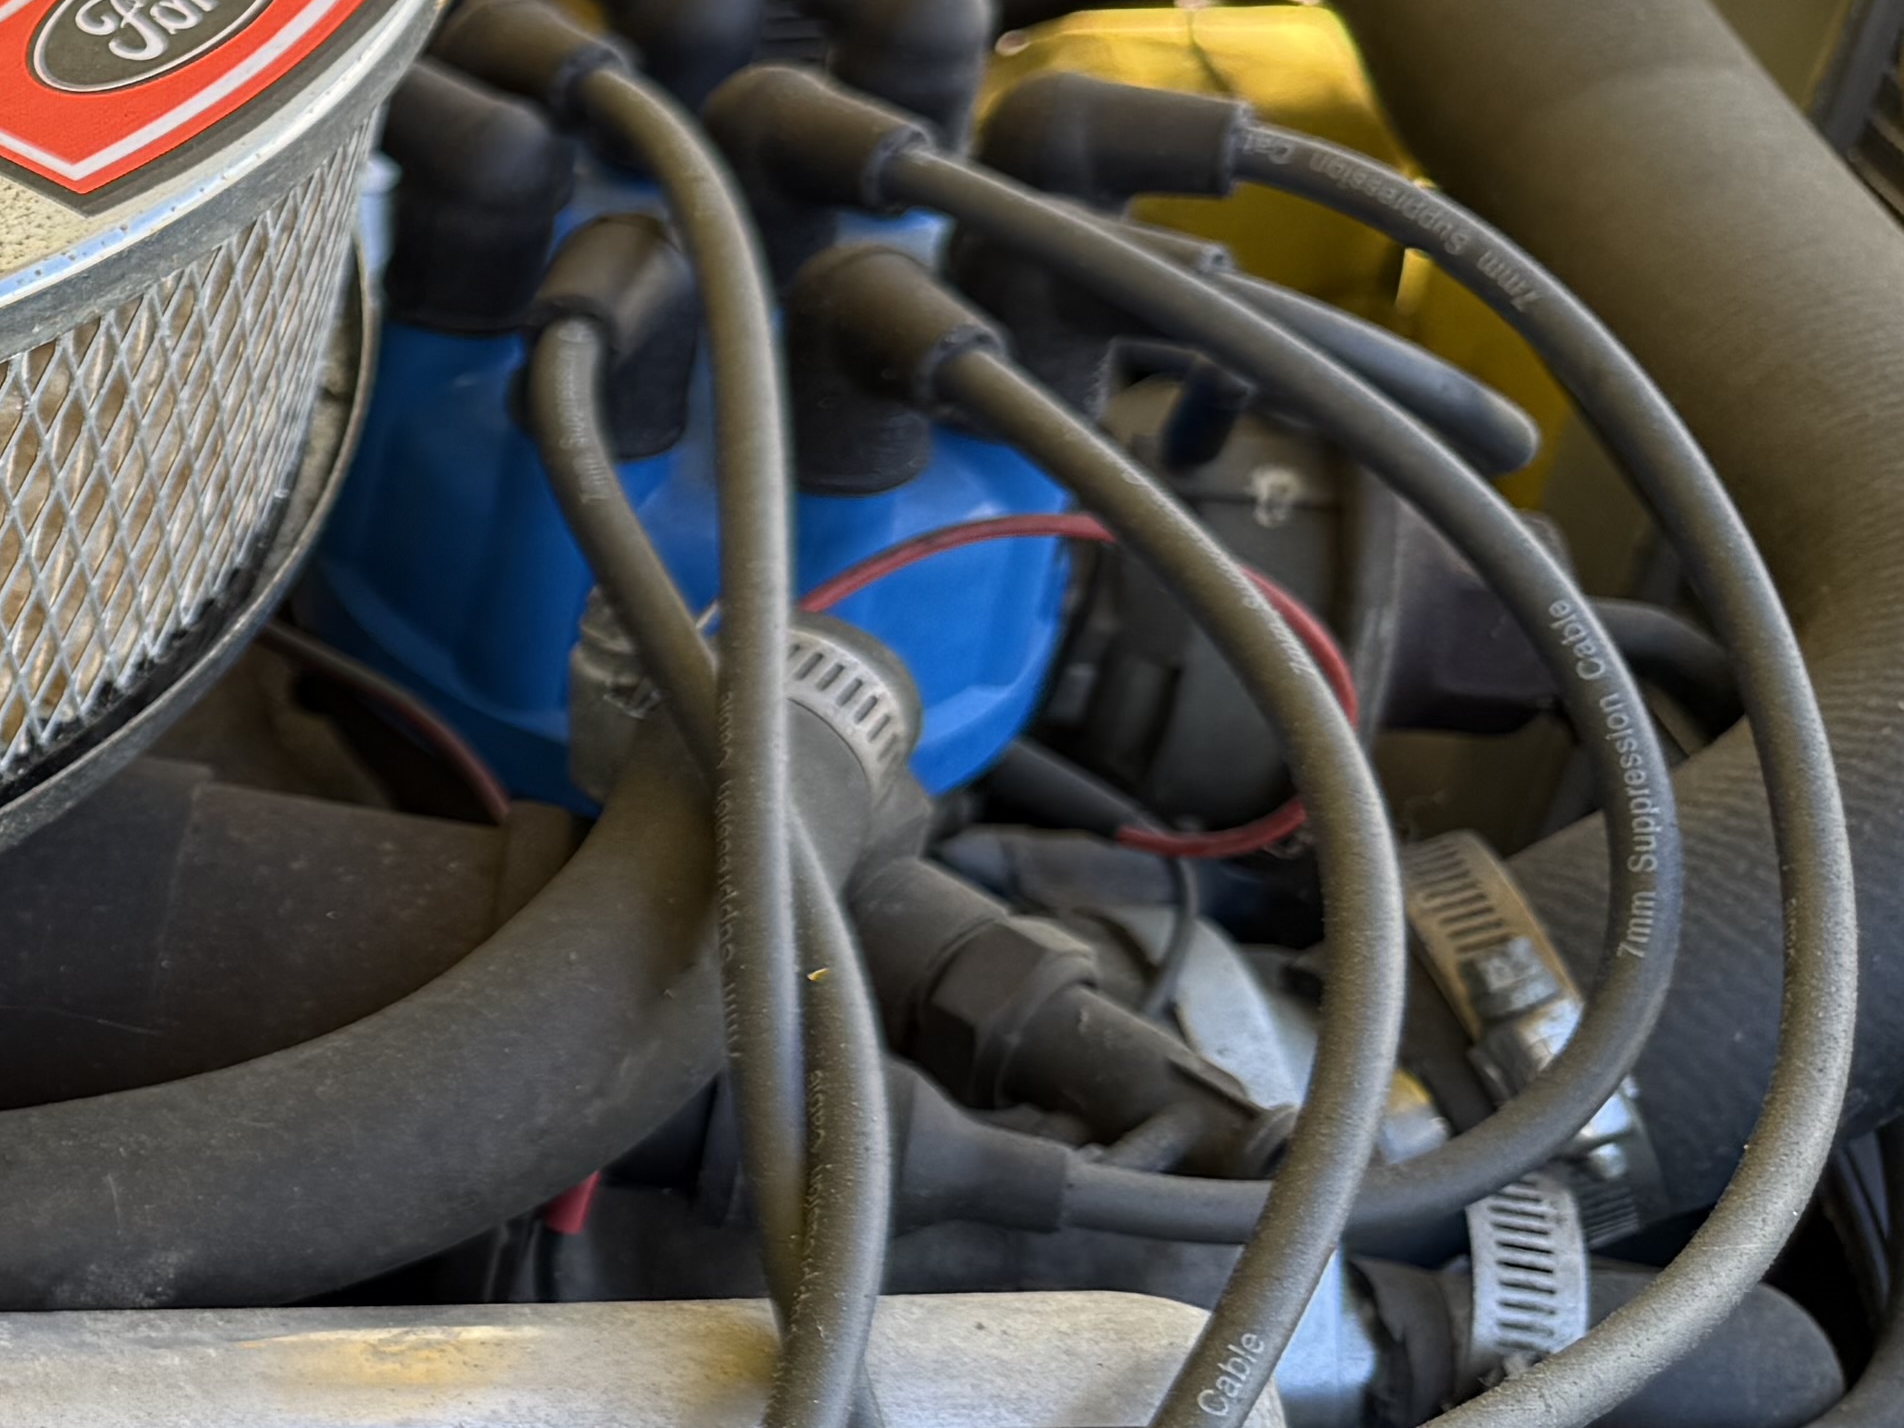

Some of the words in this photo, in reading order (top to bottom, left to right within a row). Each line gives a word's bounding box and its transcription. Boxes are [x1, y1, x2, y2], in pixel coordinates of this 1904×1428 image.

[1547, 597, 1607, 682] Cable
[1599, 692, 1662, 874] Suppression
[1616, 889, 1658, 960] 7mm
[1196, 1331, 1267, 1418] Cable
